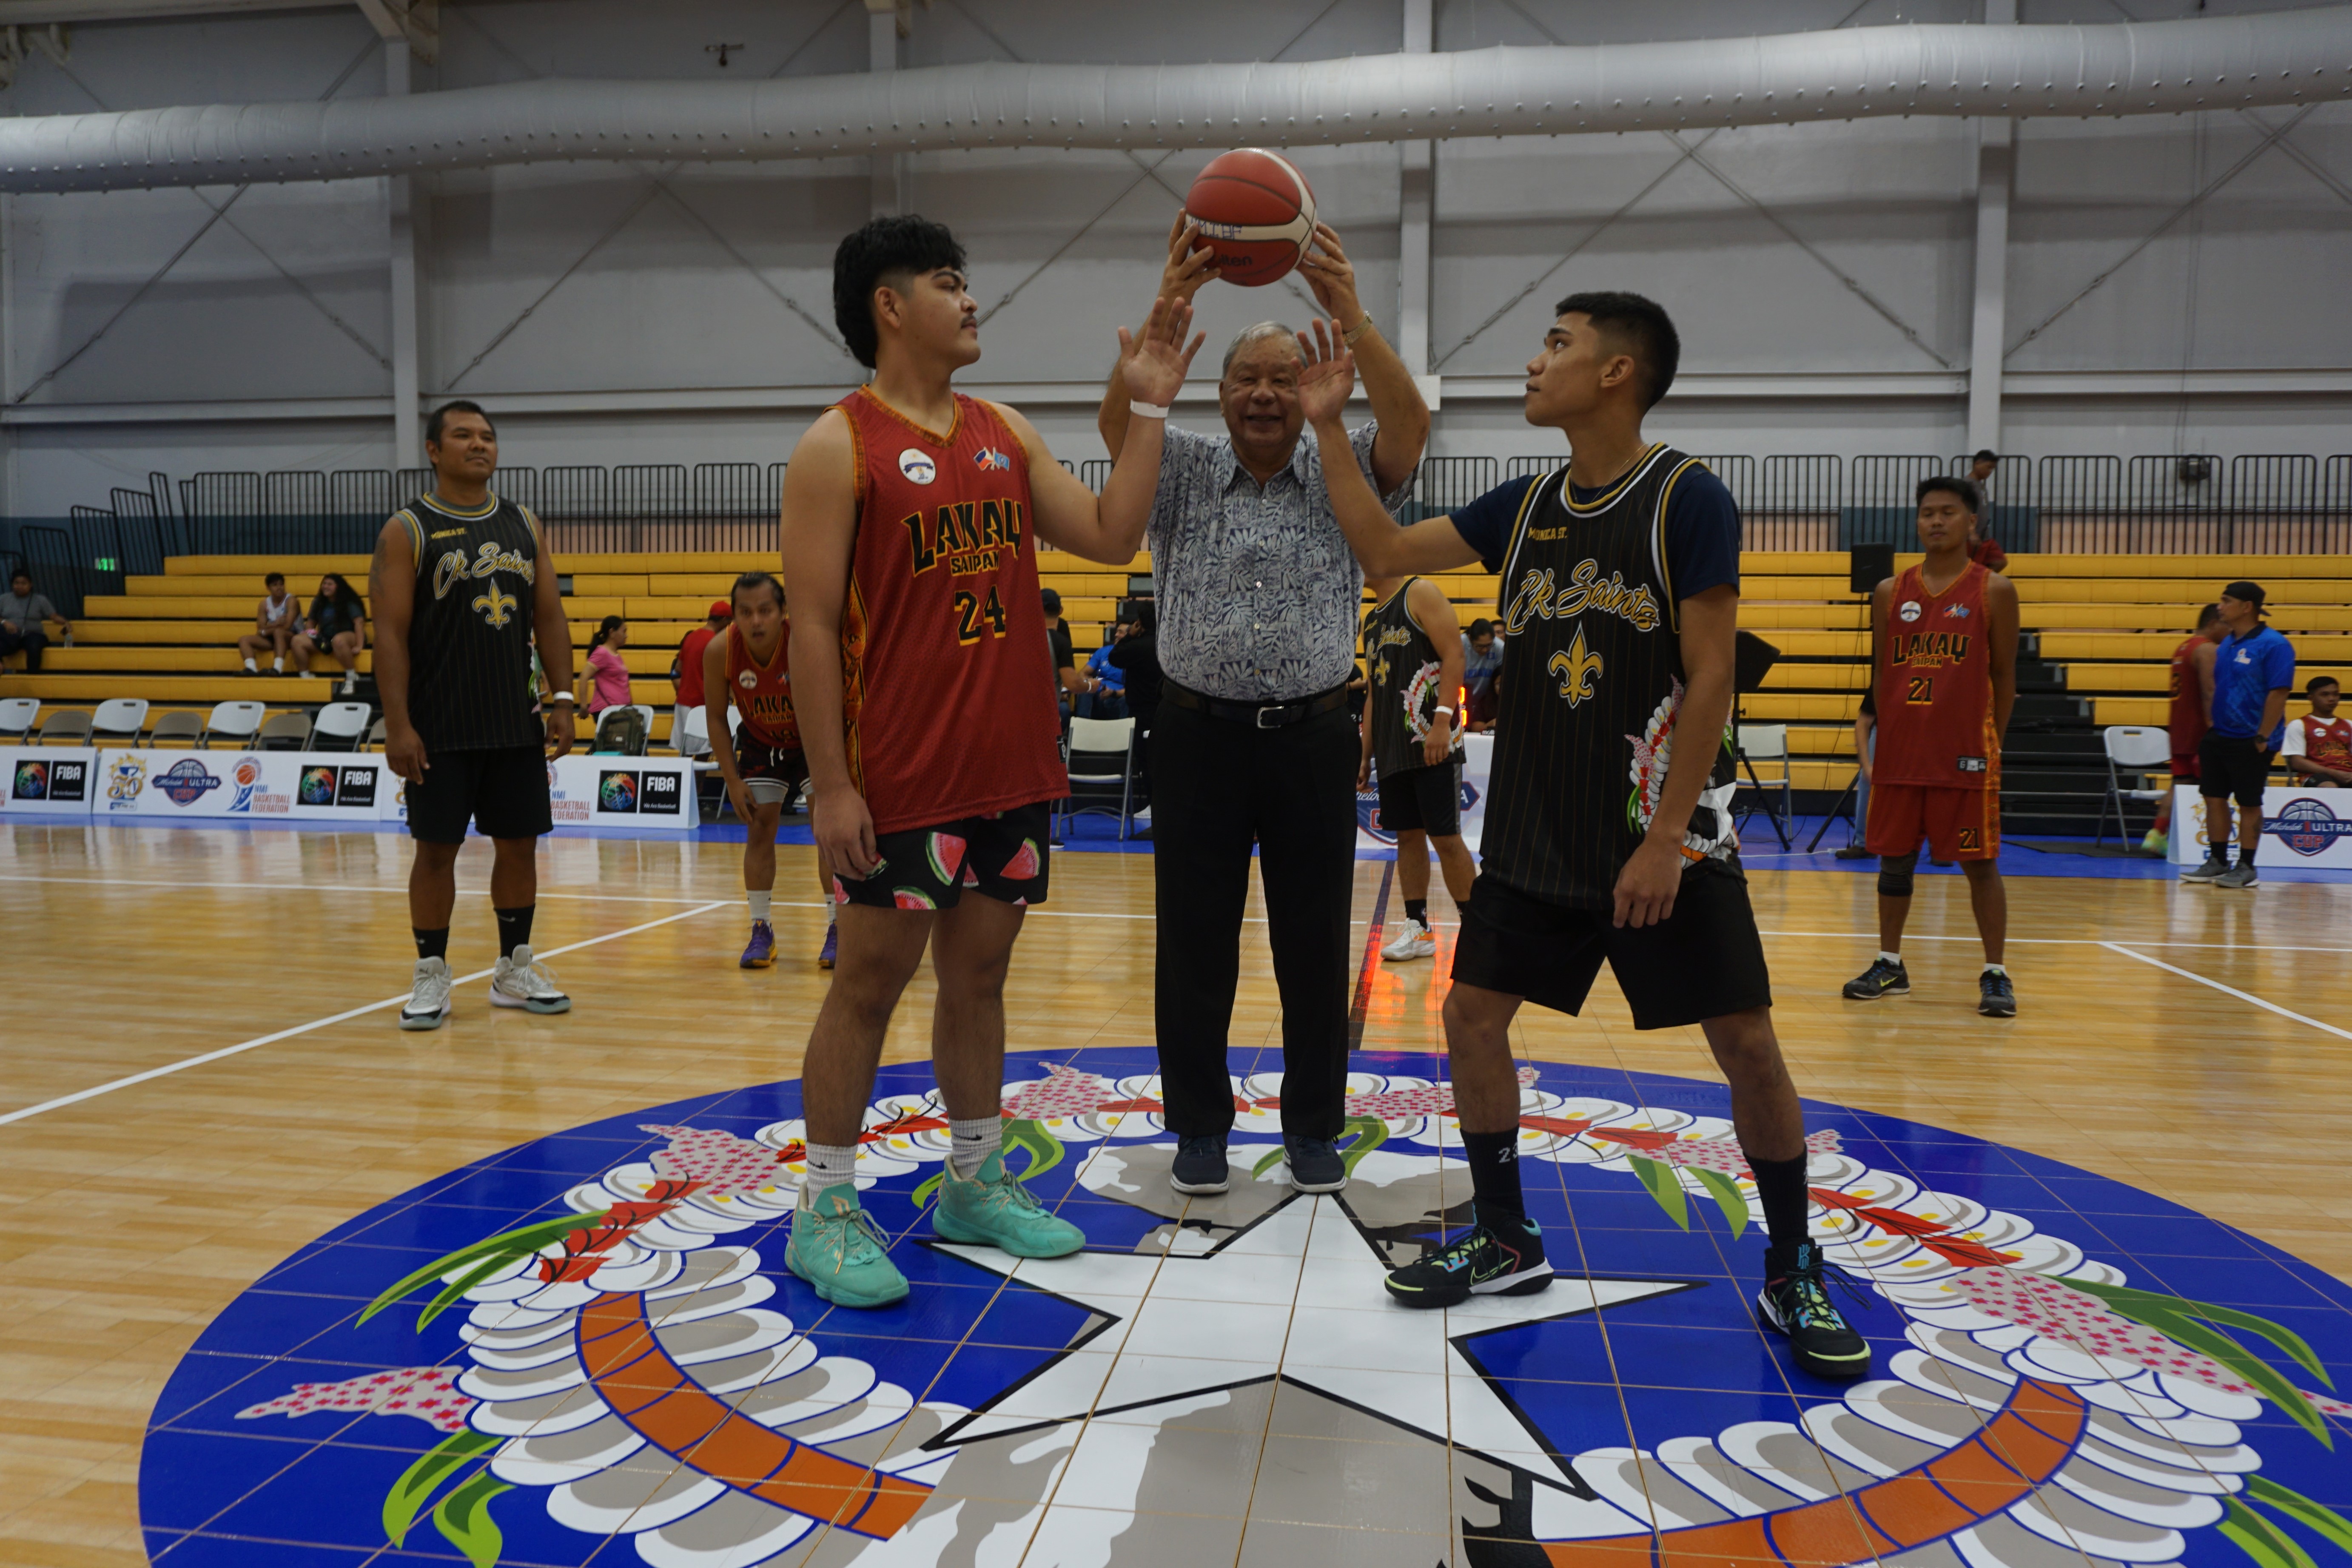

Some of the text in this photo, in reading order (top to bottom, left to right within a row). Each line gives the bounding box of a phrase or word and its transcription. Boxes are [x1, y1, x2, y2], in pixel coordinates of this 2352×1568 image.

[900, 498, 1022, 578] LAKAY
[949, 550, 999, 577] SAIPAN
[1556, 558, 1660, 632] Saints
[954, 584, 1005, 646] 24
[1892, 632, 1973, 666] LAKAY
[1906, 677, 1933, 705] 21
[56, 766, 81, 780] FIBA
[345, 770, 373, 786] FIBA
[189, 779, 218, 787] ULTRA
[647, 776, 675, 791] FIBA
[253, 793, 290, 804] BASKETBALL
[252, 804, 289, 813] FEDERATION
[2312, 823, 2352, 832] ULTRA
[1959, 827, 1980, 851] 21
[2293, 834, 2324, 848] CUP
